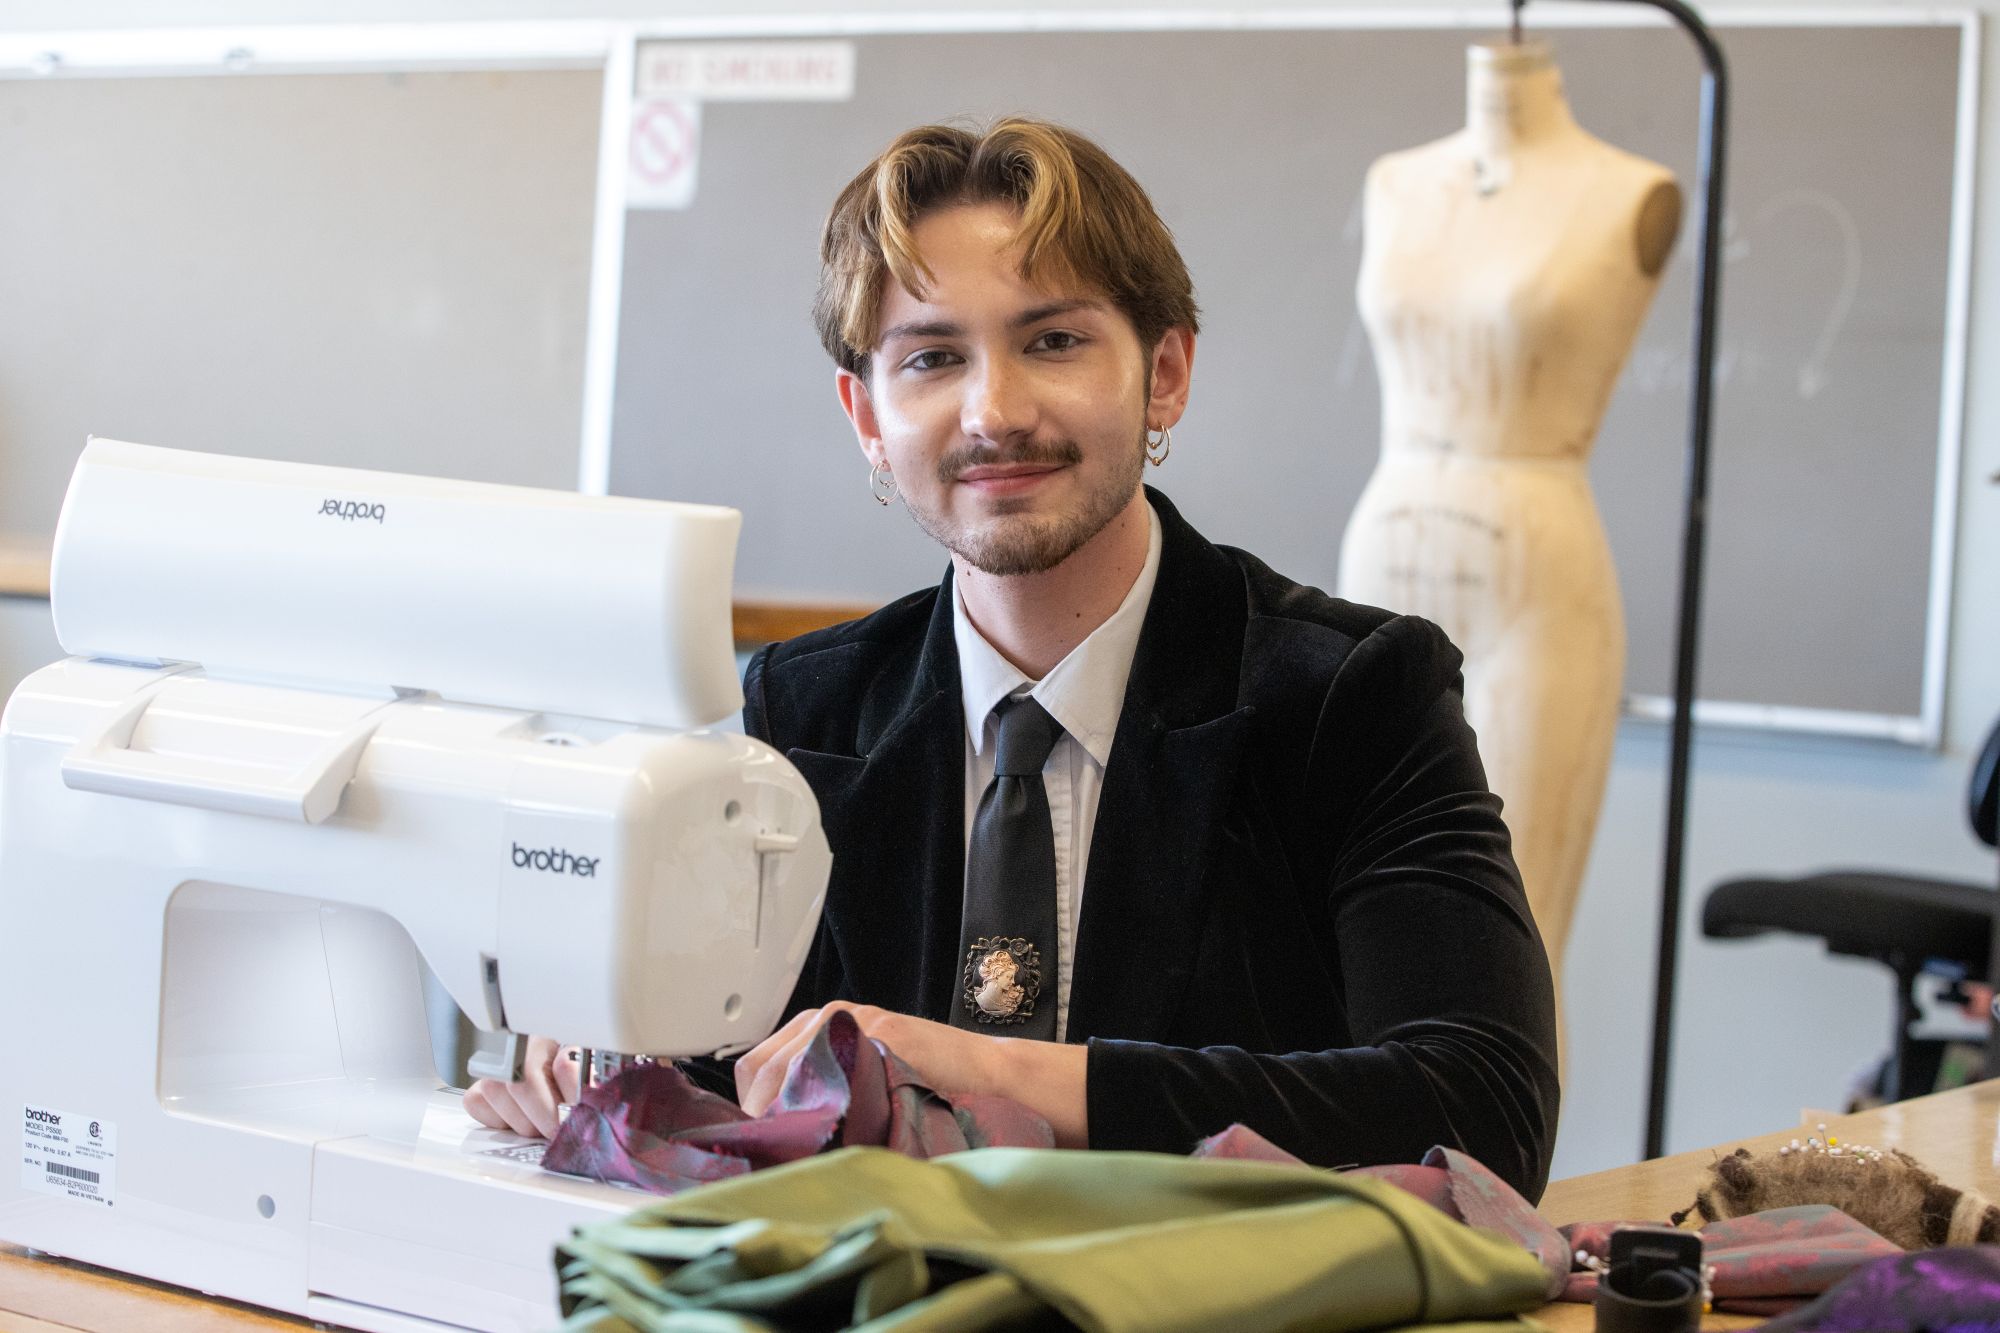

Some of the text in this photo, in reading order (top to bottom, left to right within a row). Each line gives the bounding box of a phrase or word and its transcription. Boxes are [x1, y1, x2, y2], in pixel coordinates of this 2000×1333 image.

[318, 498, 386, 525] brother
[512, 841, 600, 878] brother
[26, 1106, 61, 1125] brother
[25, 1121, 62, 1135] MODEL PS500
